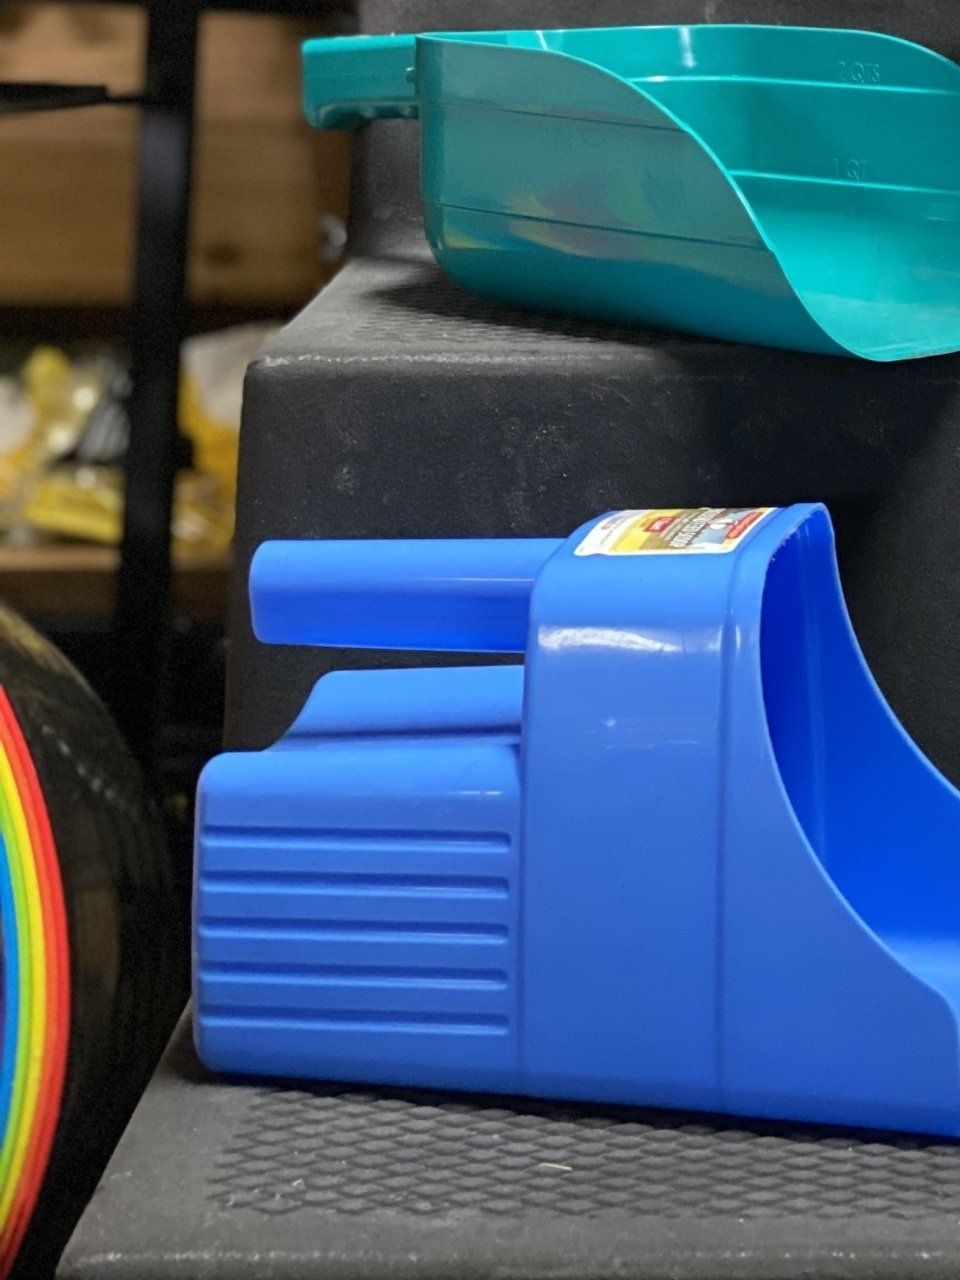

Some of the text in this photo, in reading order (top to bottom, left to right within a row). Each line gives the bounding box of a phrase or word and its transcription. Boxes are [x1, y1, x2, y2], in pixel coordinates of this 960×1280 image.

[838, 60, 880, 83] 2 QTS
[833, 158, 868, 181] 1 QT
